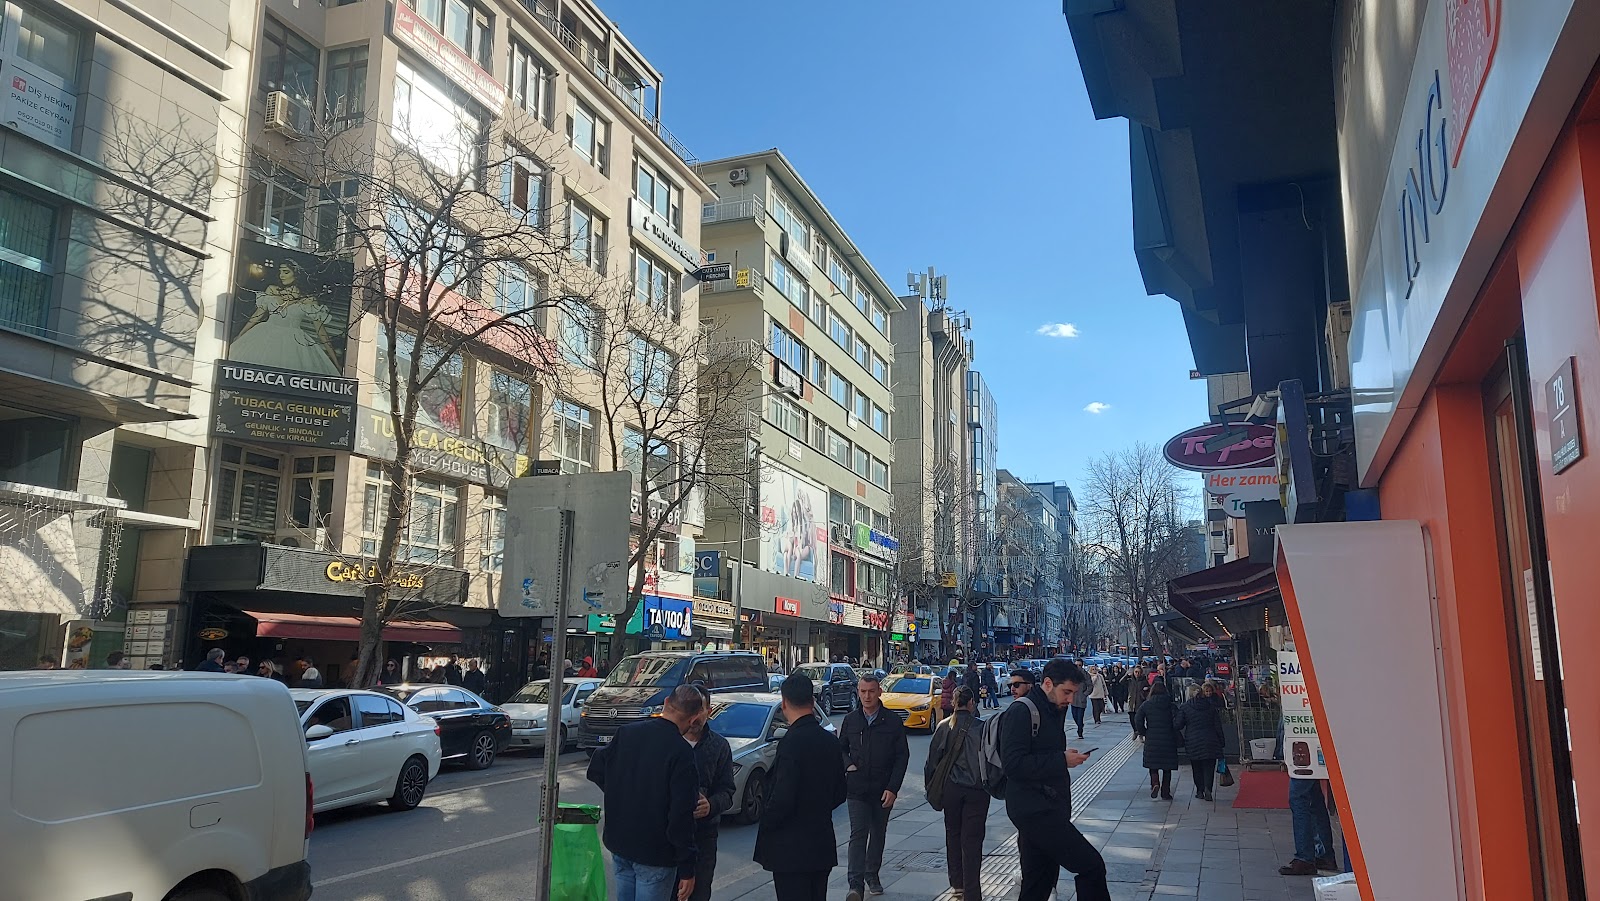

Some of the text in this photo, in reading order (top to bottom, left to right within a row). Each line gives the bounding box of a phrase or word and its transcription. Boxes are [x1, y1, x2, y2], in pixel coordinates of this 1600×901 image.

[10, 92, 70, 125] PAKİZE CEYRAN
[27, 85, 72, 112] DİŞ HEKİMİ
[1400, 69, 1449, 300] ING
[222, 366, 286, 387] TUBACA
[232, 395, 284, 411] TUBACA
[1553, 375, 1564, 410] 78
[241, 409, 330, 427] STYLE HOUSE
[442, 459, 487, 480] HOUSE
[1210, 474, 1236, 487] Her
[650, 608, 683, 629] TAVIQO
